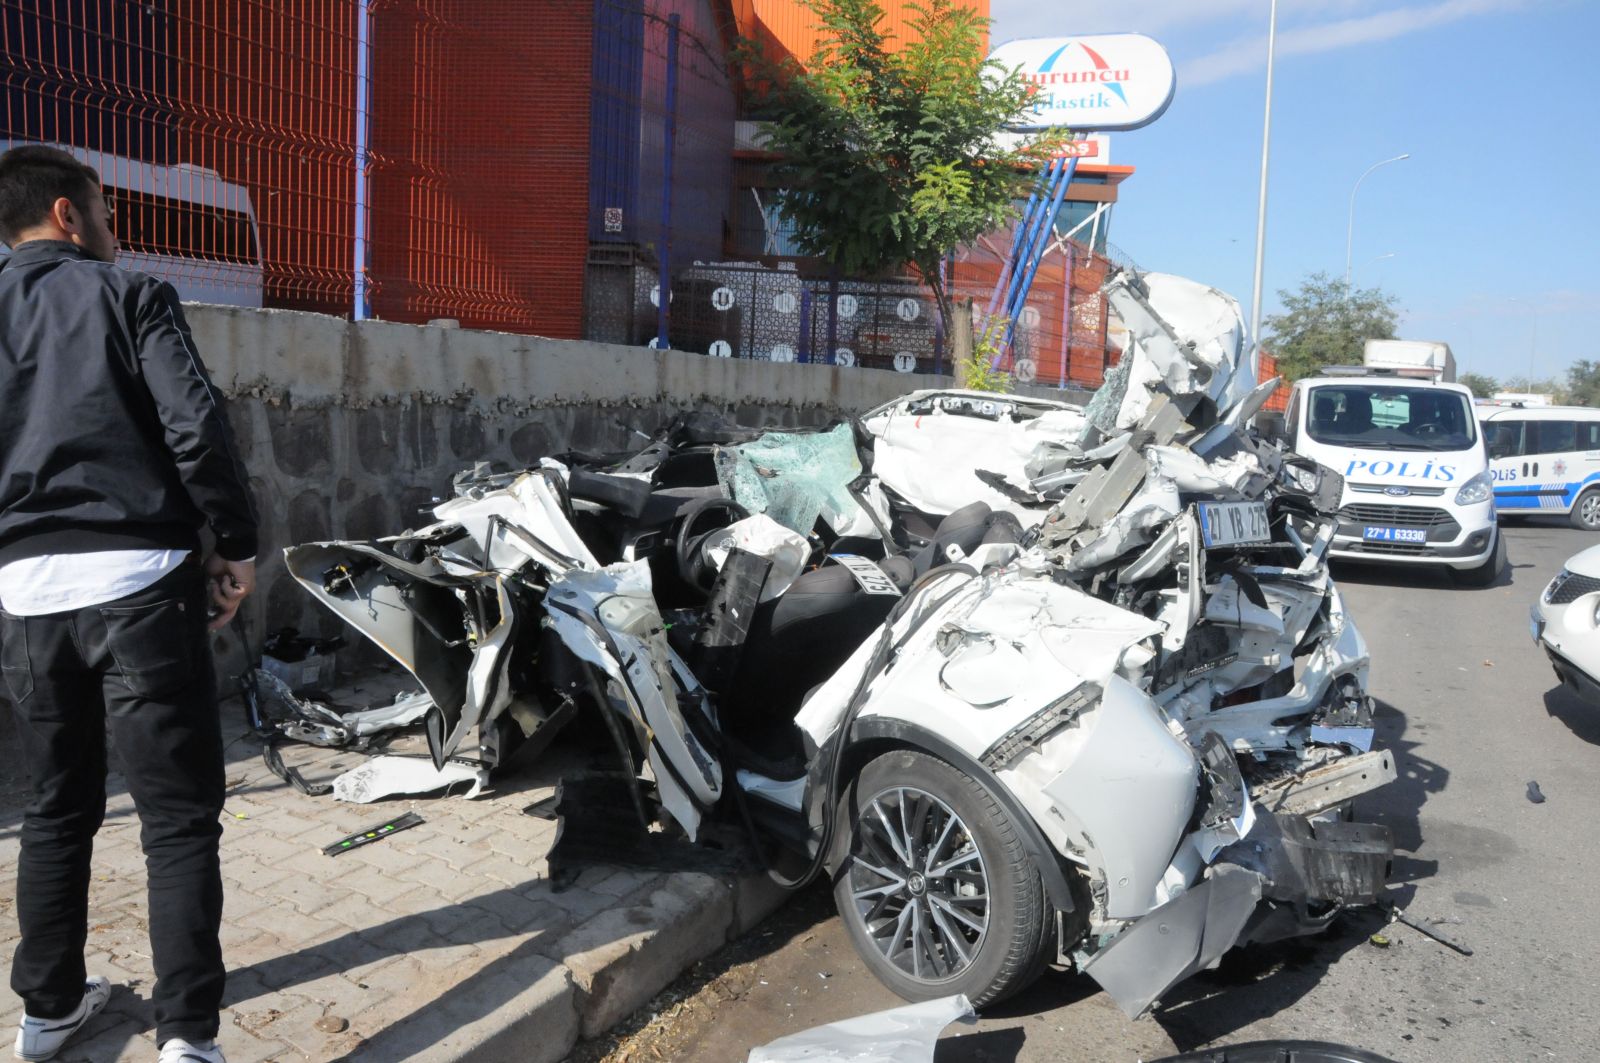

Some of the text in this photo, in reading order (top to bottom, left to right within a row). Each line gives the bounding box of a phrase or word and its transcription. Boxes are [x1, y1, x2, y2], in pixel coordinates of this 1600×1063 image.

[1345, 459, 1457, 482] POLİS
[1366, 527, 1425, 541] 27 A 63330
